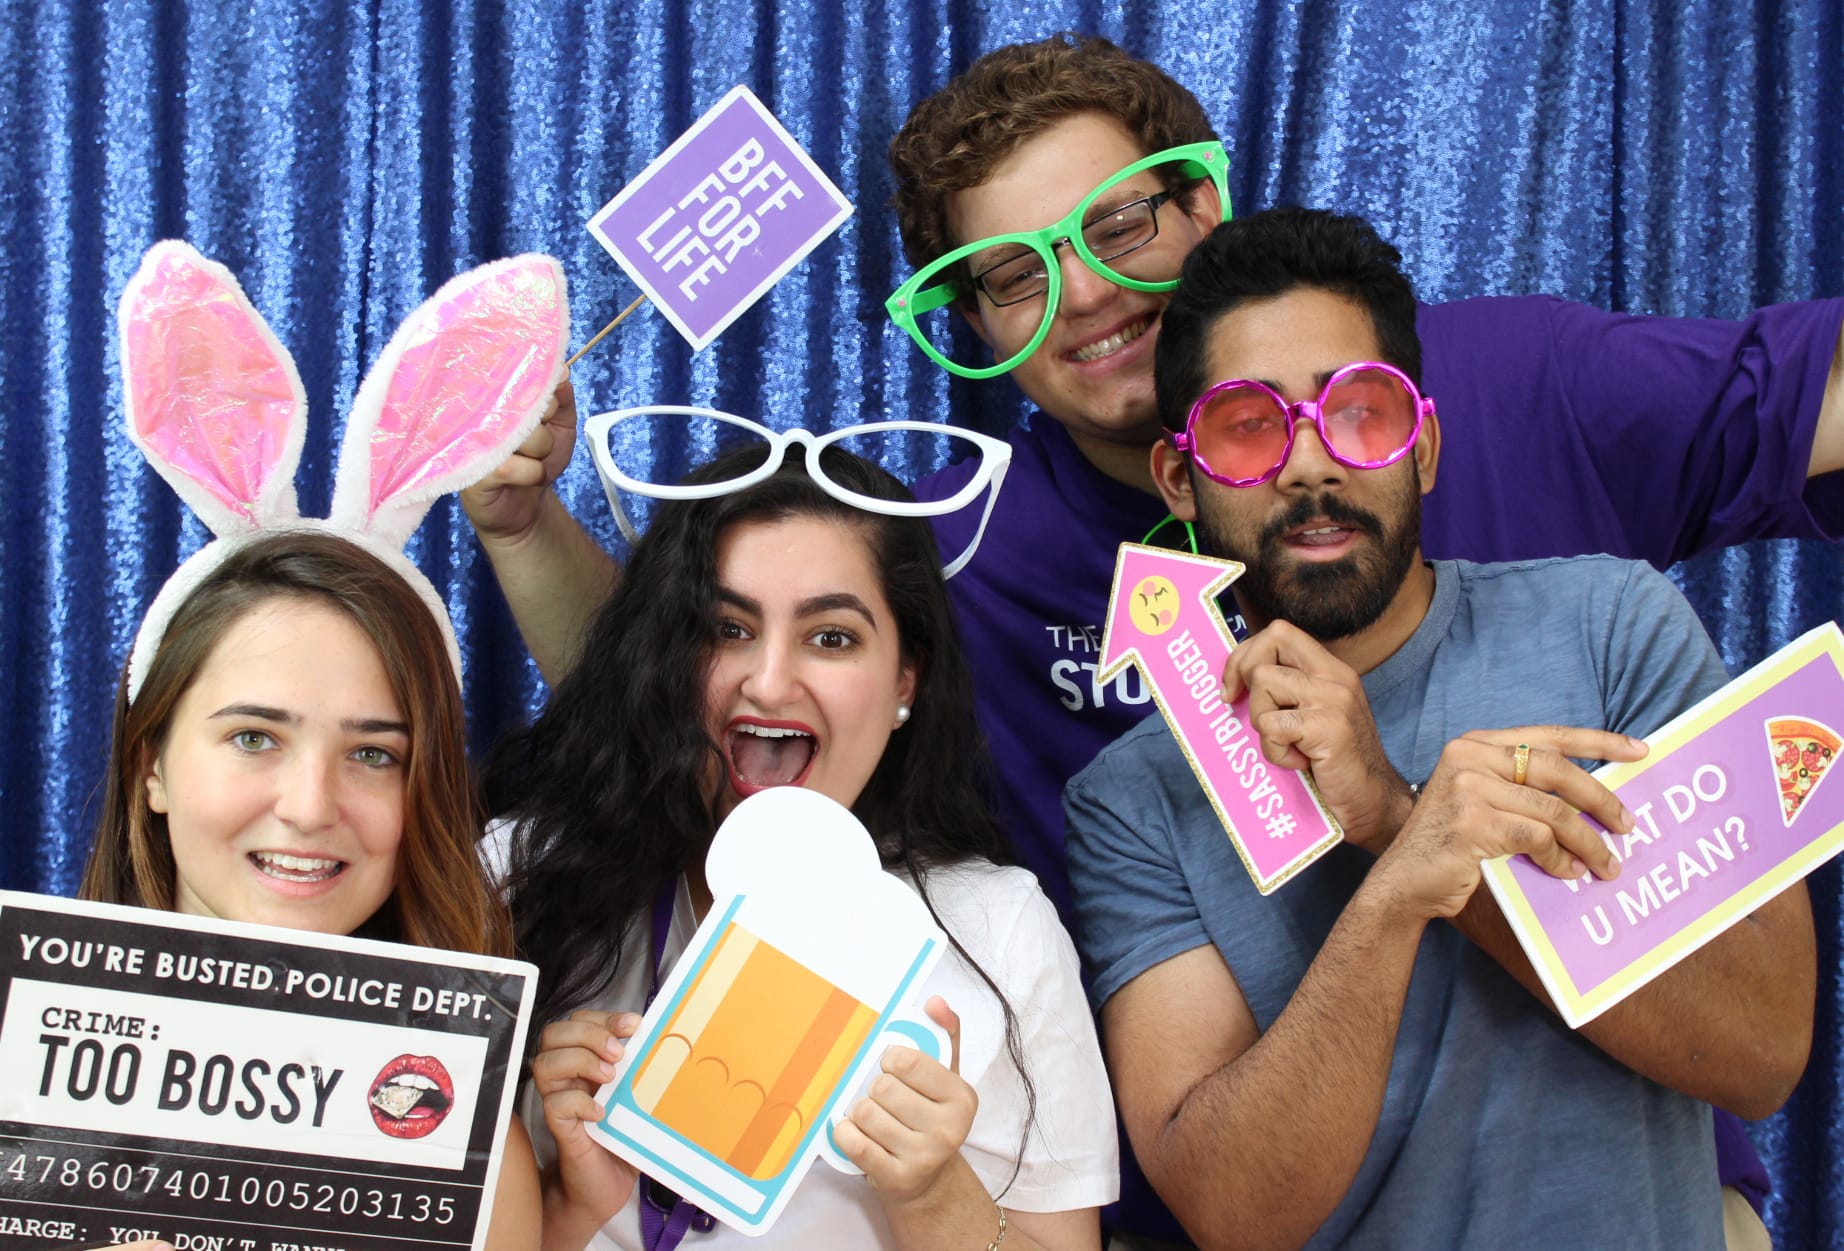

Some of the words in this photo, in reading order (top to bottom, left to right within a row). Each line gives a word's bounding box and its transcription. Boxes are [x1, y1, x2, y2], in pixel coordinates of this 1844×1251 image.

[678, 172, 760, 264] FOR
[718, 137, 804, 216] BFF
[636, 206, 727, 302] LIFE
[1167, 629, 1297, 839] #SASSYBLOGGER
[1561, 802, 1662, 893] AT
[1662, 764, 1727, 824] DO
[1581, 905, 1614, 945] U
[1616, 816, 1750, 926] MEAN?
[20, 934, 145, 974] YOU'RE
[155, 952, 273, 991] BUSTED
[285, 969, 402, 1008] POLICE
[412, 987, 492, 1020] DEPT.
[41, 1007, 160, 1040] CRIME:
[39, 1034, 142, 1105] TOO
[158, 1049, 344, 1127] BOSSY
[0, 1151, 455, 1224] 478607401005203135
[175, 1233, 256, 1251] DON'T
